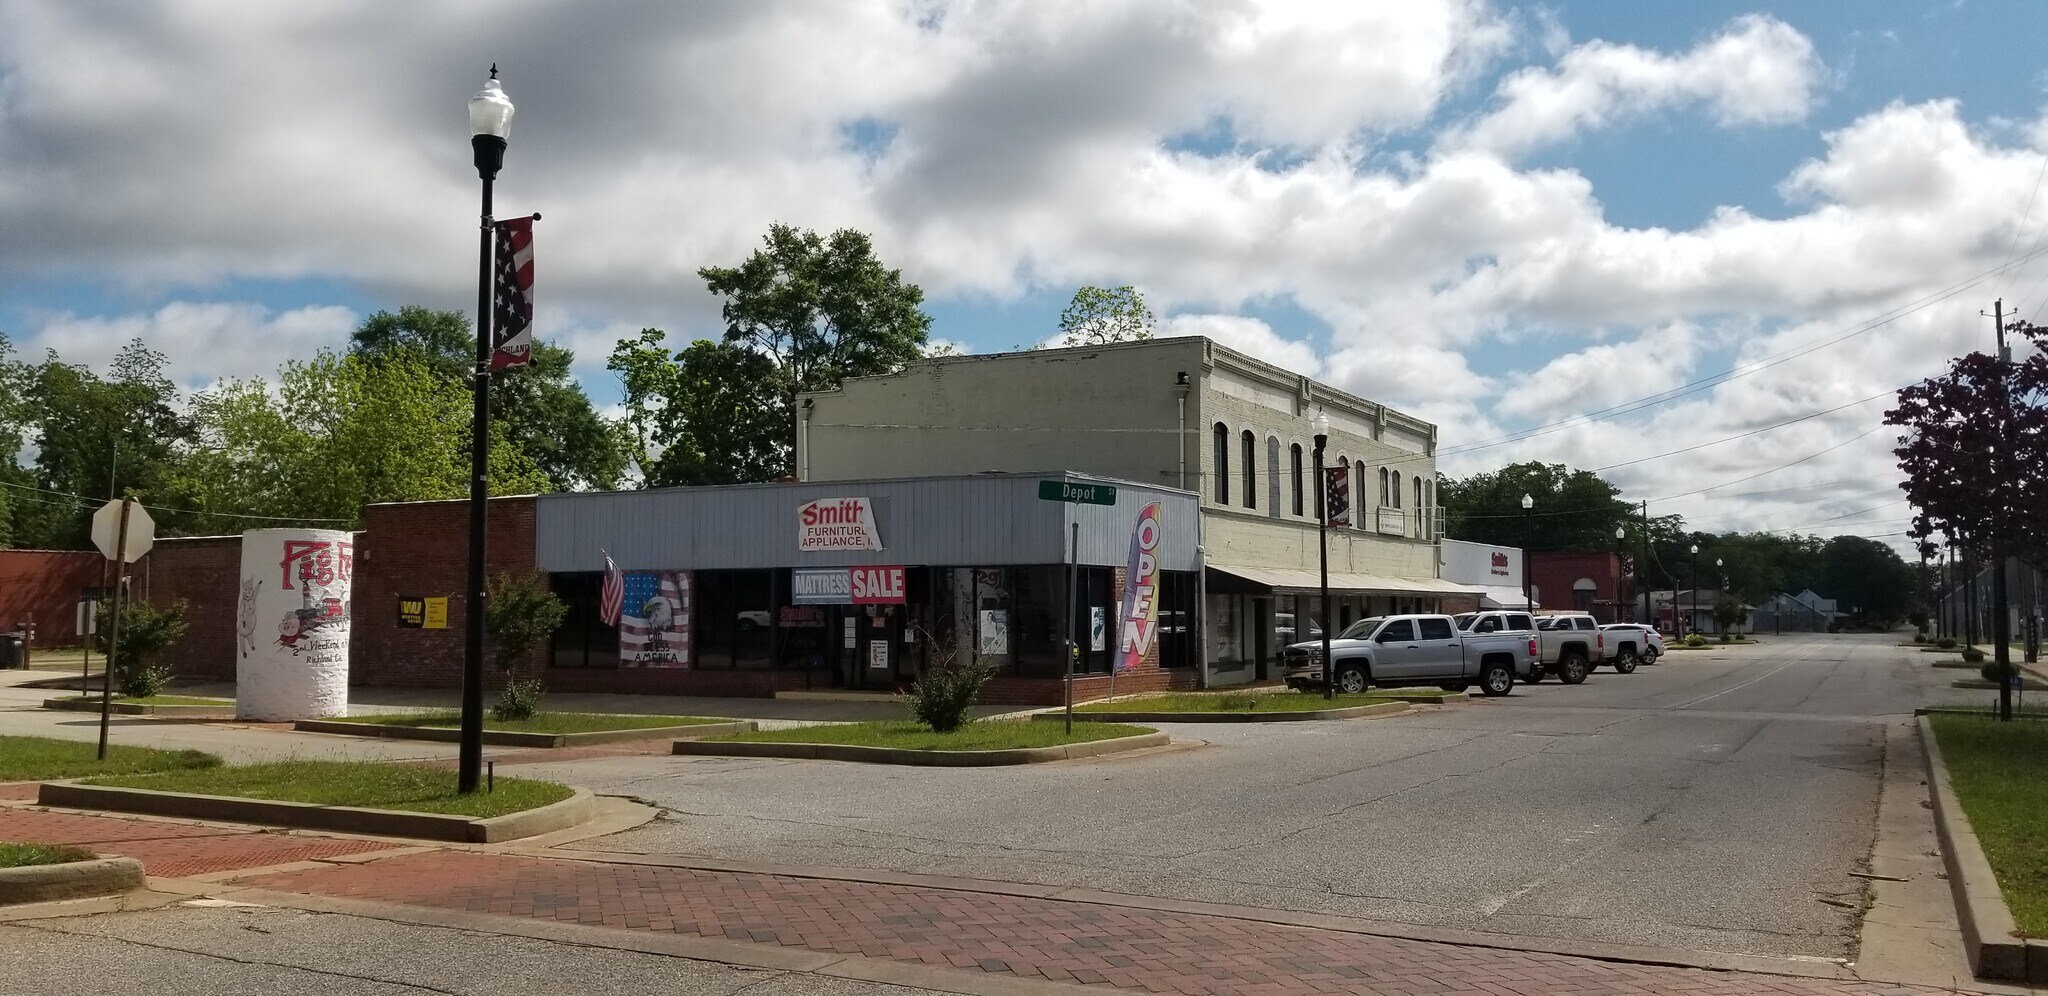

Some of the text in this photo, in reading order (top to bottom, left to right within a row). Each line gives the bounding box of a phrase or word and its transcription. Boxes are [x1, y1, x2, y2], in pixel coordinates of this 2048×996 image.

[1063, 484, 1096, 501] Depot
[802, 537, 865, 547] APPLIANCE,
[279, 540, 335, 590] Pig
[795, 569, 904, 598] MATTRESS SALE
[1121, 517, 1160, 657] OPEN
[647, 632, 663, 641] GOD
[635, 652, 679, 663] AMERICA
